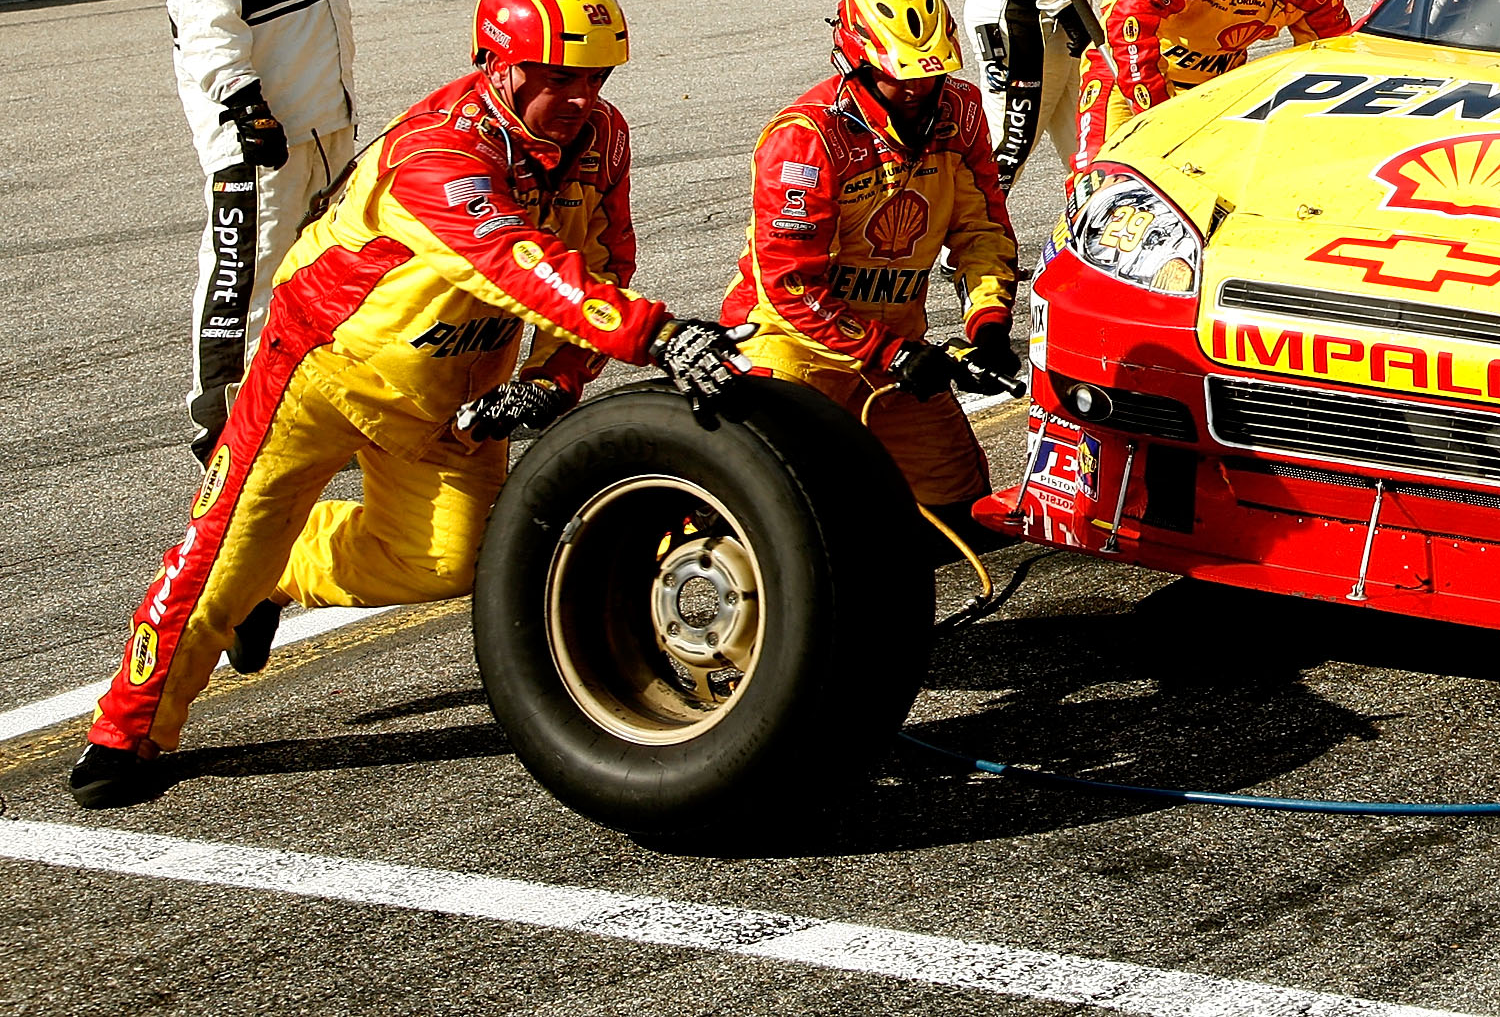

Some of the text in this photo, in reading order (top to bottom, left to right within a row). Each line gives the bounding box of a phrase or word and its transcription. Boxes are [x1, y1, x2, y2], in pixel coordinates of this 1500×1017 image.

[482, 18, 512, 49] PENNZOIL
[583, 3, 612, 26] 29
[918, 56, 943, 71] 29
[1127, 43, 1142, 82] Shell
[613, 129, 626, 167] SIMPSON
[998, 98, 1031, 171] Sprint
[224, 182, 253, 192] NASCAR
[1099, 205, 1155, 253] 29
[212, 207, 244, 303] Sprint
[534, 262, 585, 305] Shell
[200, 328, 244, 338] SERIES
[209, 316, 239, 327] CUP
[200, 455, 224, 508] PENNZOIL
